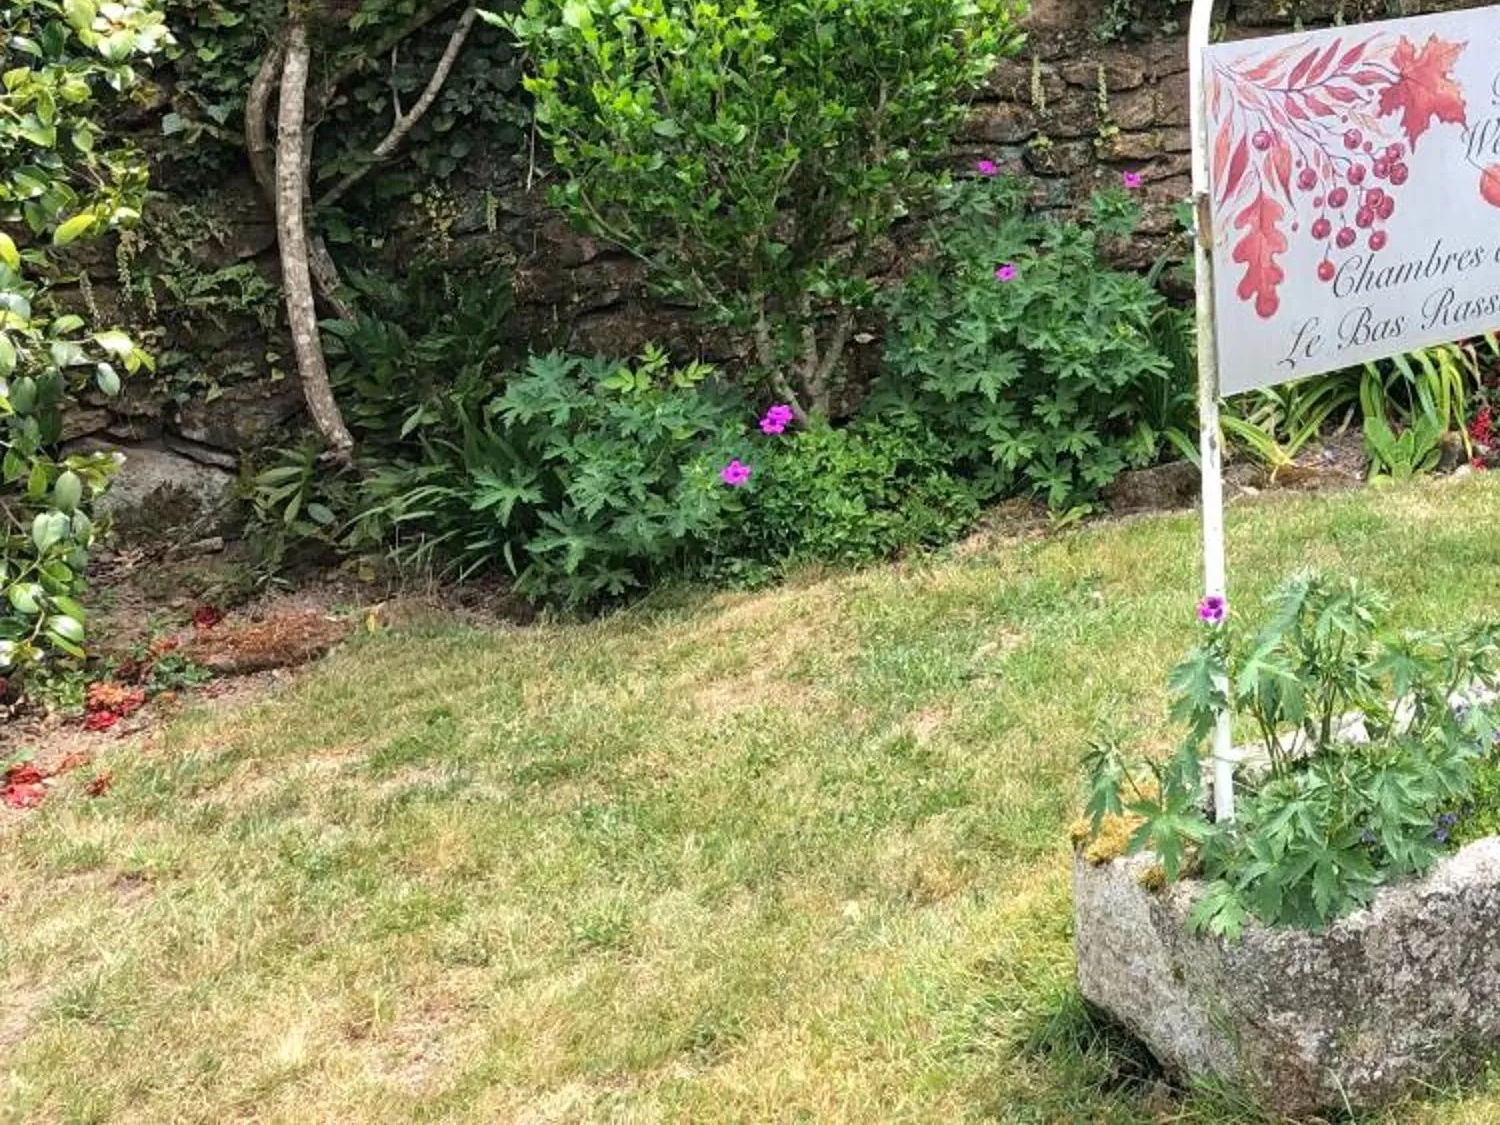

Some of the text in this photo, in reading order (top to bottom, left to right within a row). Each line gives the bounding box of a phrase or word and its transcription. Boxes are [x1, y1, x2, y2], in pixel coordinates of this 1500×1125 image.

[1333, 240, 1485, 298] Chambres
[1277, 317, 1324, 369] Le
[1337, 306, 1405, 350] Bas
